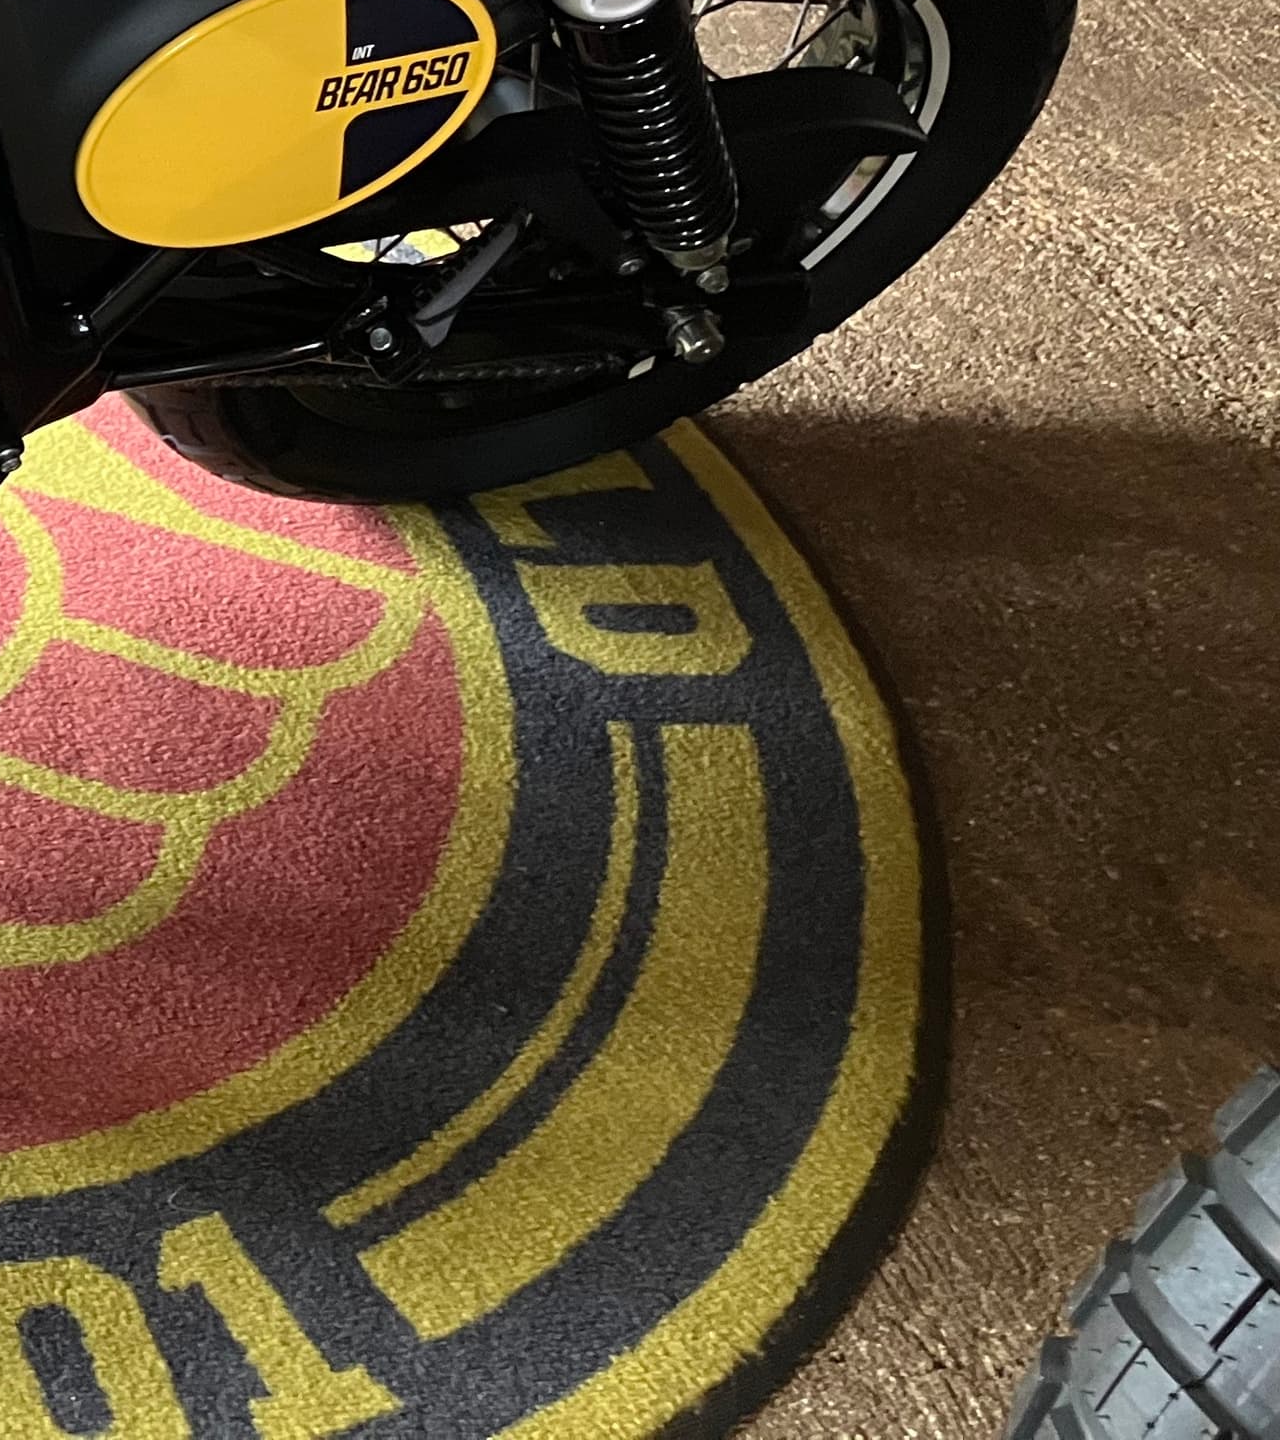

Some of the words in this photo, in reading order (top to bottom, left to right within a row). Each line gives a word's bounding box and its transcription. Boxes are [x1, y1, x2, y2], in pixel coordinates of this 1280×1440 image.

[351, 44, 376, 61] INT
[315, 65, 402, 113] BEAR
[402, 51, 471, 96] 650
